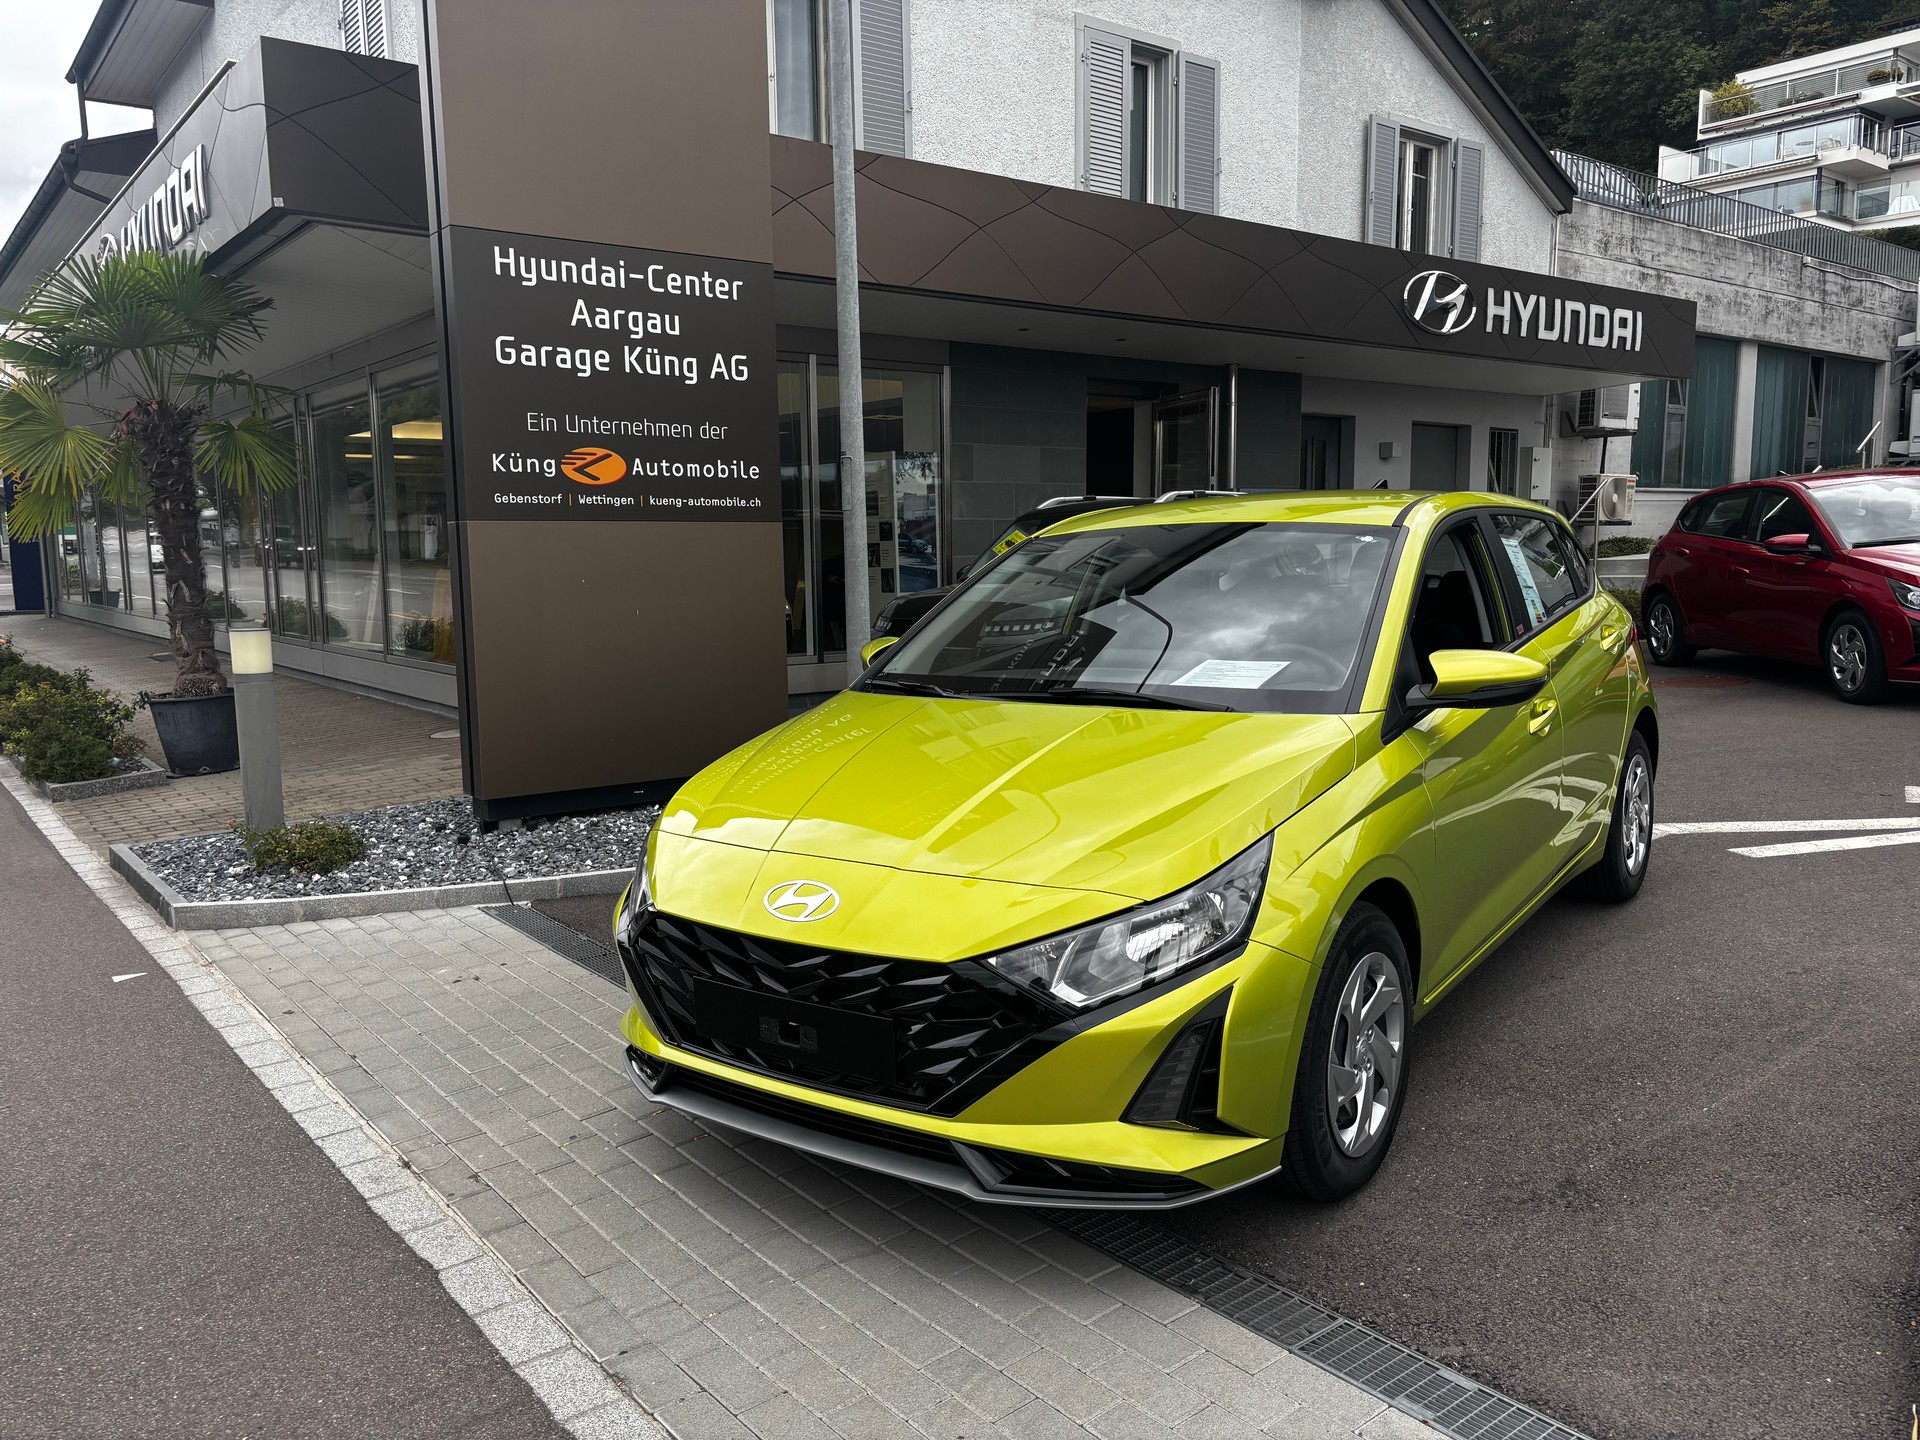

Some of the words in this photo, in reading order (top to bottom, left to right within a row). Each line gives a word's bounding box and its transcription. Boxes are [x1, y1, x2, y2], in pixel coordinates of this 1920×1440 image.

[121, 144, 207, 264] HYUNDAI
[493, 245, 744, 301] Hyundai-Center
[570, 298, 680, 340] Aargau
[1486, 287, 1643, 351] HYUNDAI
[495, 335, 610, 378] Garage
[623, 345, 698, 385] Küng
[709, 352, 749, 382] AG
[527, 412, 557, 432] Ein
[565, 414, 693, 438] Unternehmen
[699, 421, 728, 440] der
[492, 452, 556, 478] Küng
[632, 457, 760, 479] Automobile
[494, 492, 563, 504] Gebenstorf
[578, 494, 634, 507] Wettingen
[649, 495, 761, 508] kueng-automobile.ch
